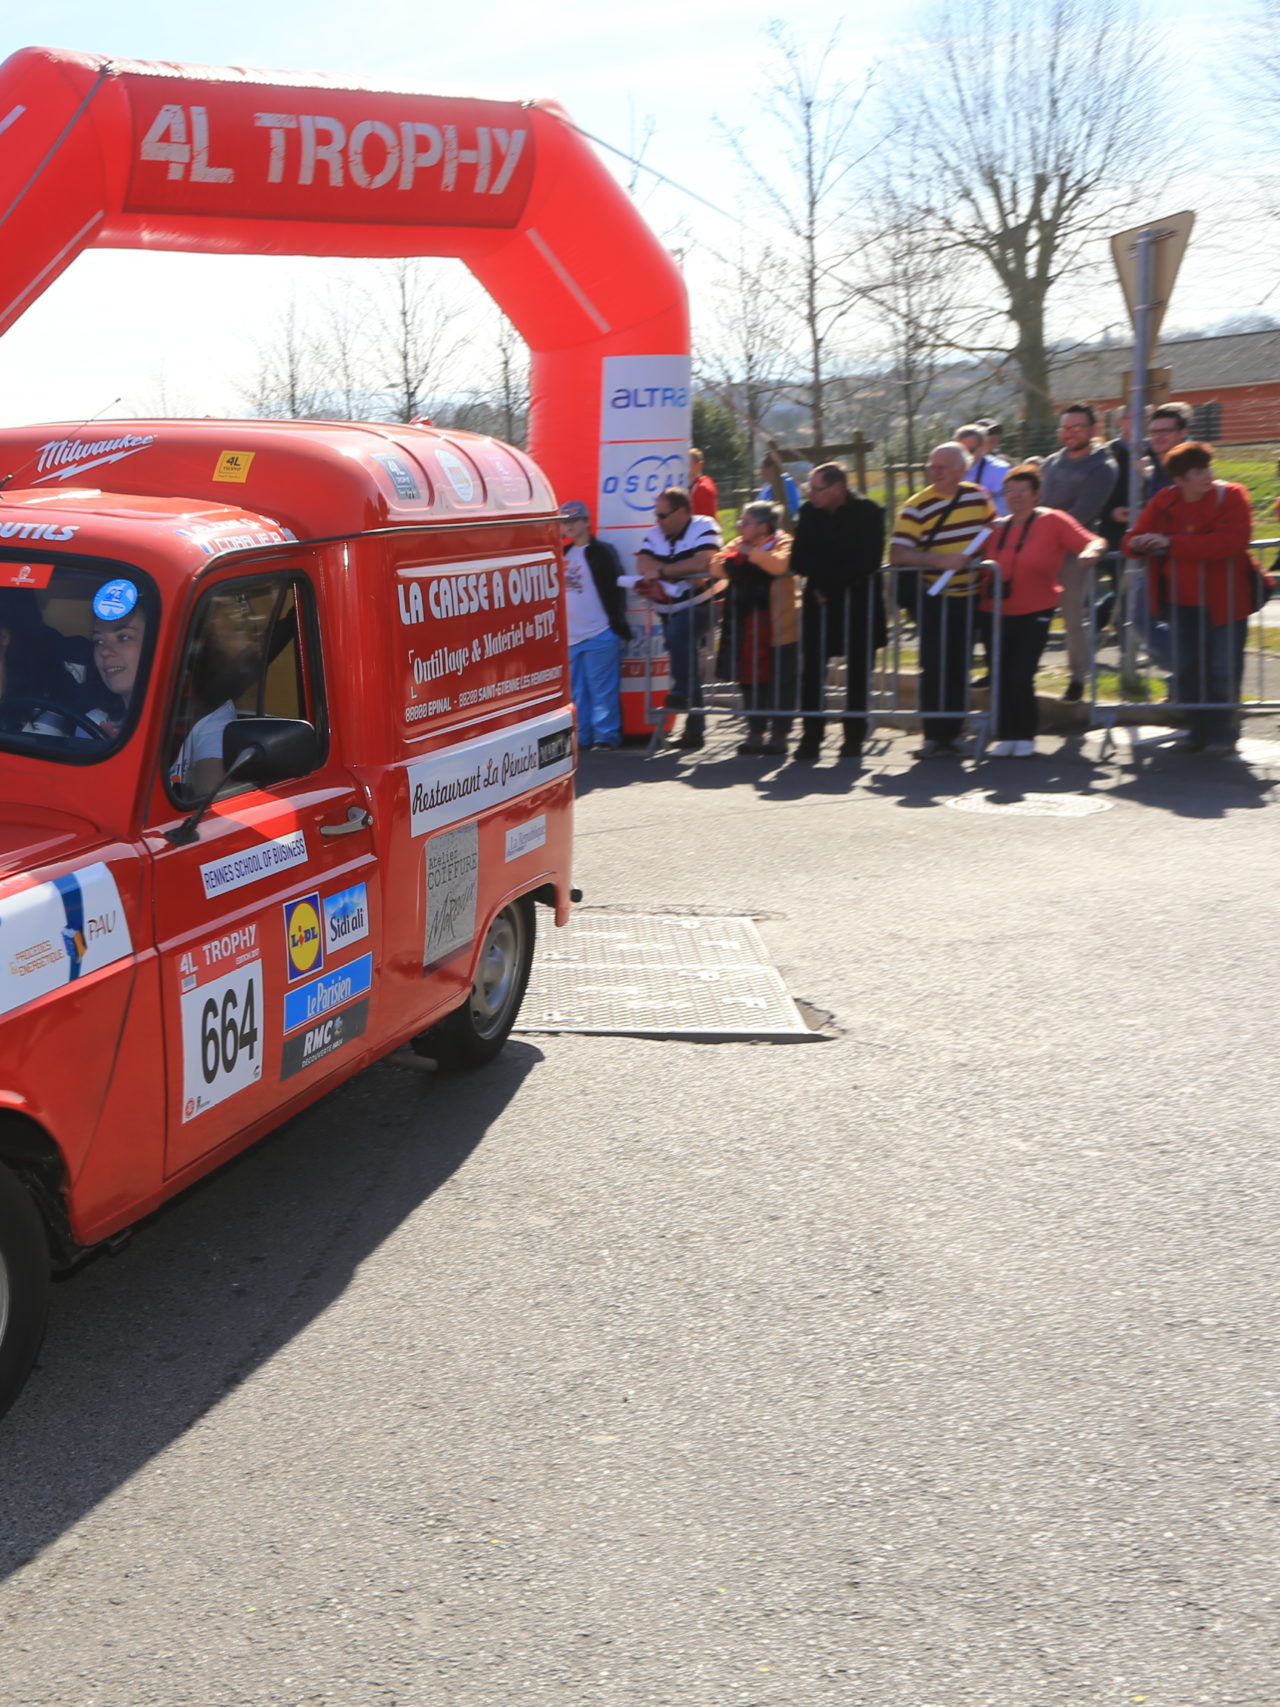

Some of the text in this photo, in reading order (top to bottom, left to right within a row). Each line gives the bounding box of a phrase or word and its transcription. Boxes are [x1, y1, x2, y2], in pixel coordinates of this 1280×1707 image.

[140, 104, 527, 195] 4L TROPHY
[36, 434, 154, 473] Milwaukee
[226, 456, 240, 466] 4L
[397, 581, 425, 625] LA
[428, 573, 490, 619] CAISSE
[492, 571, 506, 609] A
[508, 563, 560, 606] OUTILS
[413, 646, 470, 685] Outillage
[471, 638, 482, 663] &
[483, 621, 525, 659] Matériel
[534, 609, 556, 641] BTP
[428, 697, 452, 718] EPINAL
[412, 743, 537, 816] Restaurant La Péniche
[203, 837, 306, 891] RENNES SCHOOL OF BUSINESS
[427, 852, 478, 890] COIFFURE
[428, 849, 458, 870] Atelier
[87, 910, 116, 941] PAU
[330, 907, 365, 942] Sidi ali
[180, 924, 257, 975] 4L TROPHY
[307, 976, 352, 1018] Le Parisien
[201, 978, 258, 1084] 664
[303, 1020, 334, 1058] RMC
